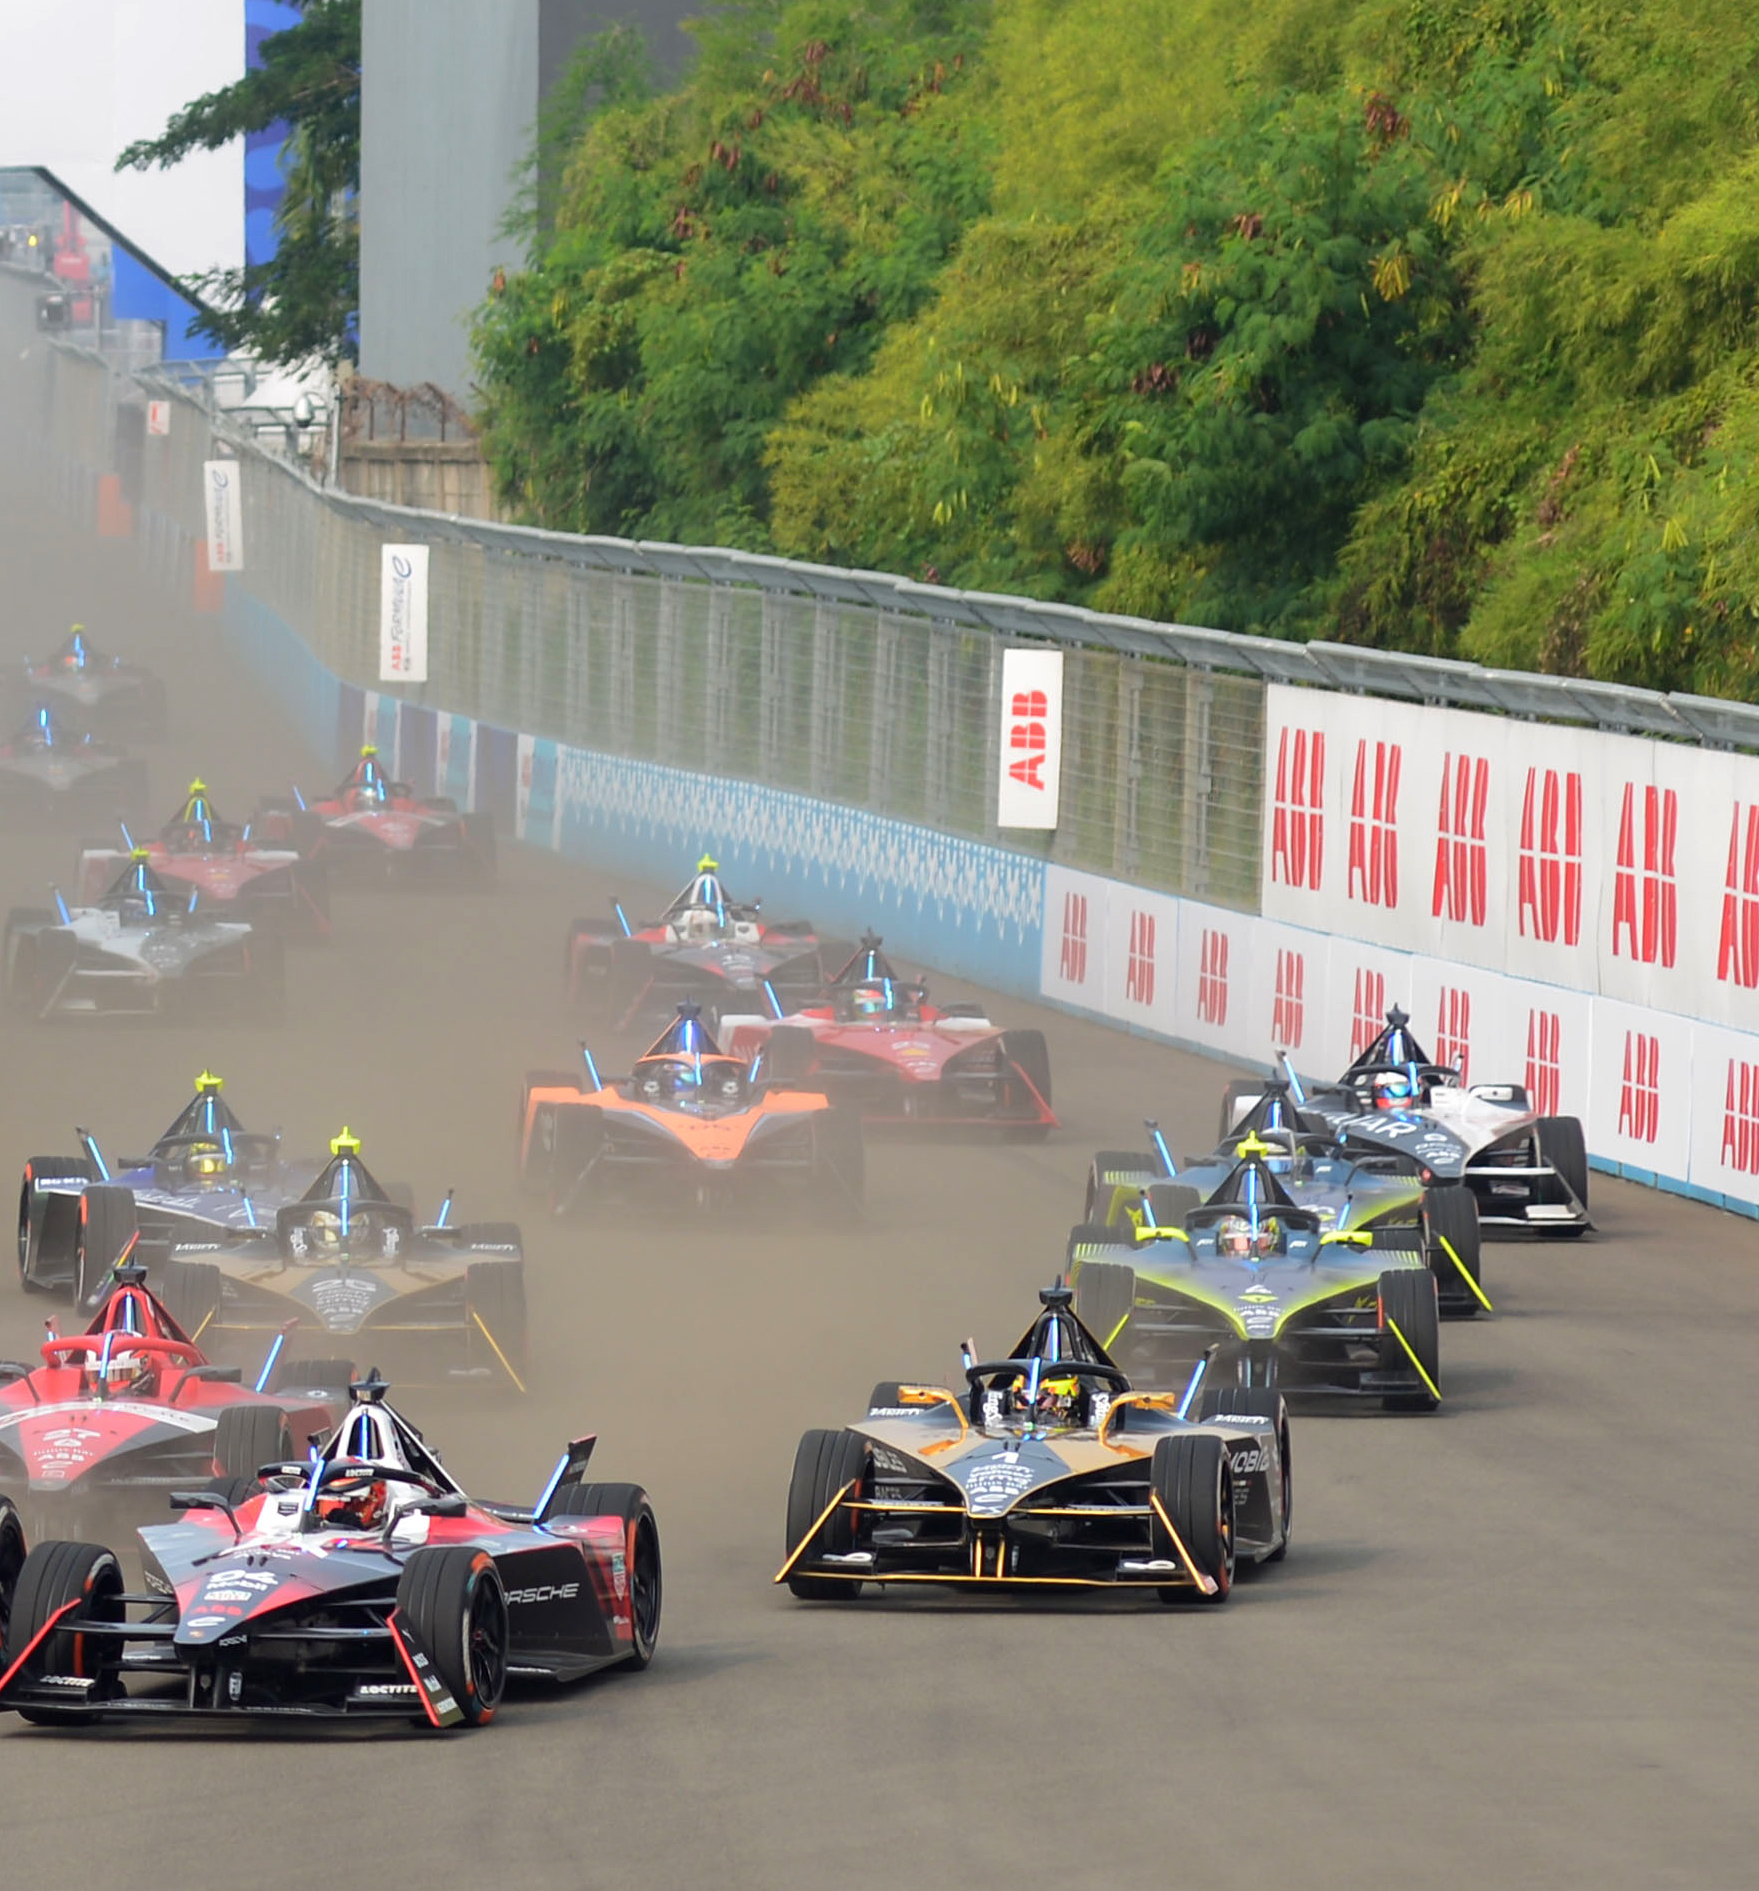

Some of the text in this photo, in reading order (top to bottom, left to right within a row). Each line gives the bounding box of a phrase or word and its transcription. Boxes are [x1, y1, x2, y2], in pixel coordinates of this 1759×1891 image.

[1007, 688, 1048, 792] ABB
[1271, 725, 1325, 892] ABB
[1347, 738, 1402, 909] ABB
[1431, 751, 1489, 927] ABB
[1518, 766, 1583, 947] ABB
[1612, 781, 1679, 969] ABB
[1716, 800, 1759, 990] AB
[1059, 891, 1088, 985] ABB
[1125, 909, 1156, 1006] ABB
[1197, 929, 1229, 1026] ABB
[1271, 948, 1304, 1049] ABB
[1524, 1008, 1561, 1117] ABB
[1618, 1030, 1660, 1144] ABB
[1214, 1413, 1271, 1425] VARIETY
[503, 1582, 581, 1606] RSCHE
